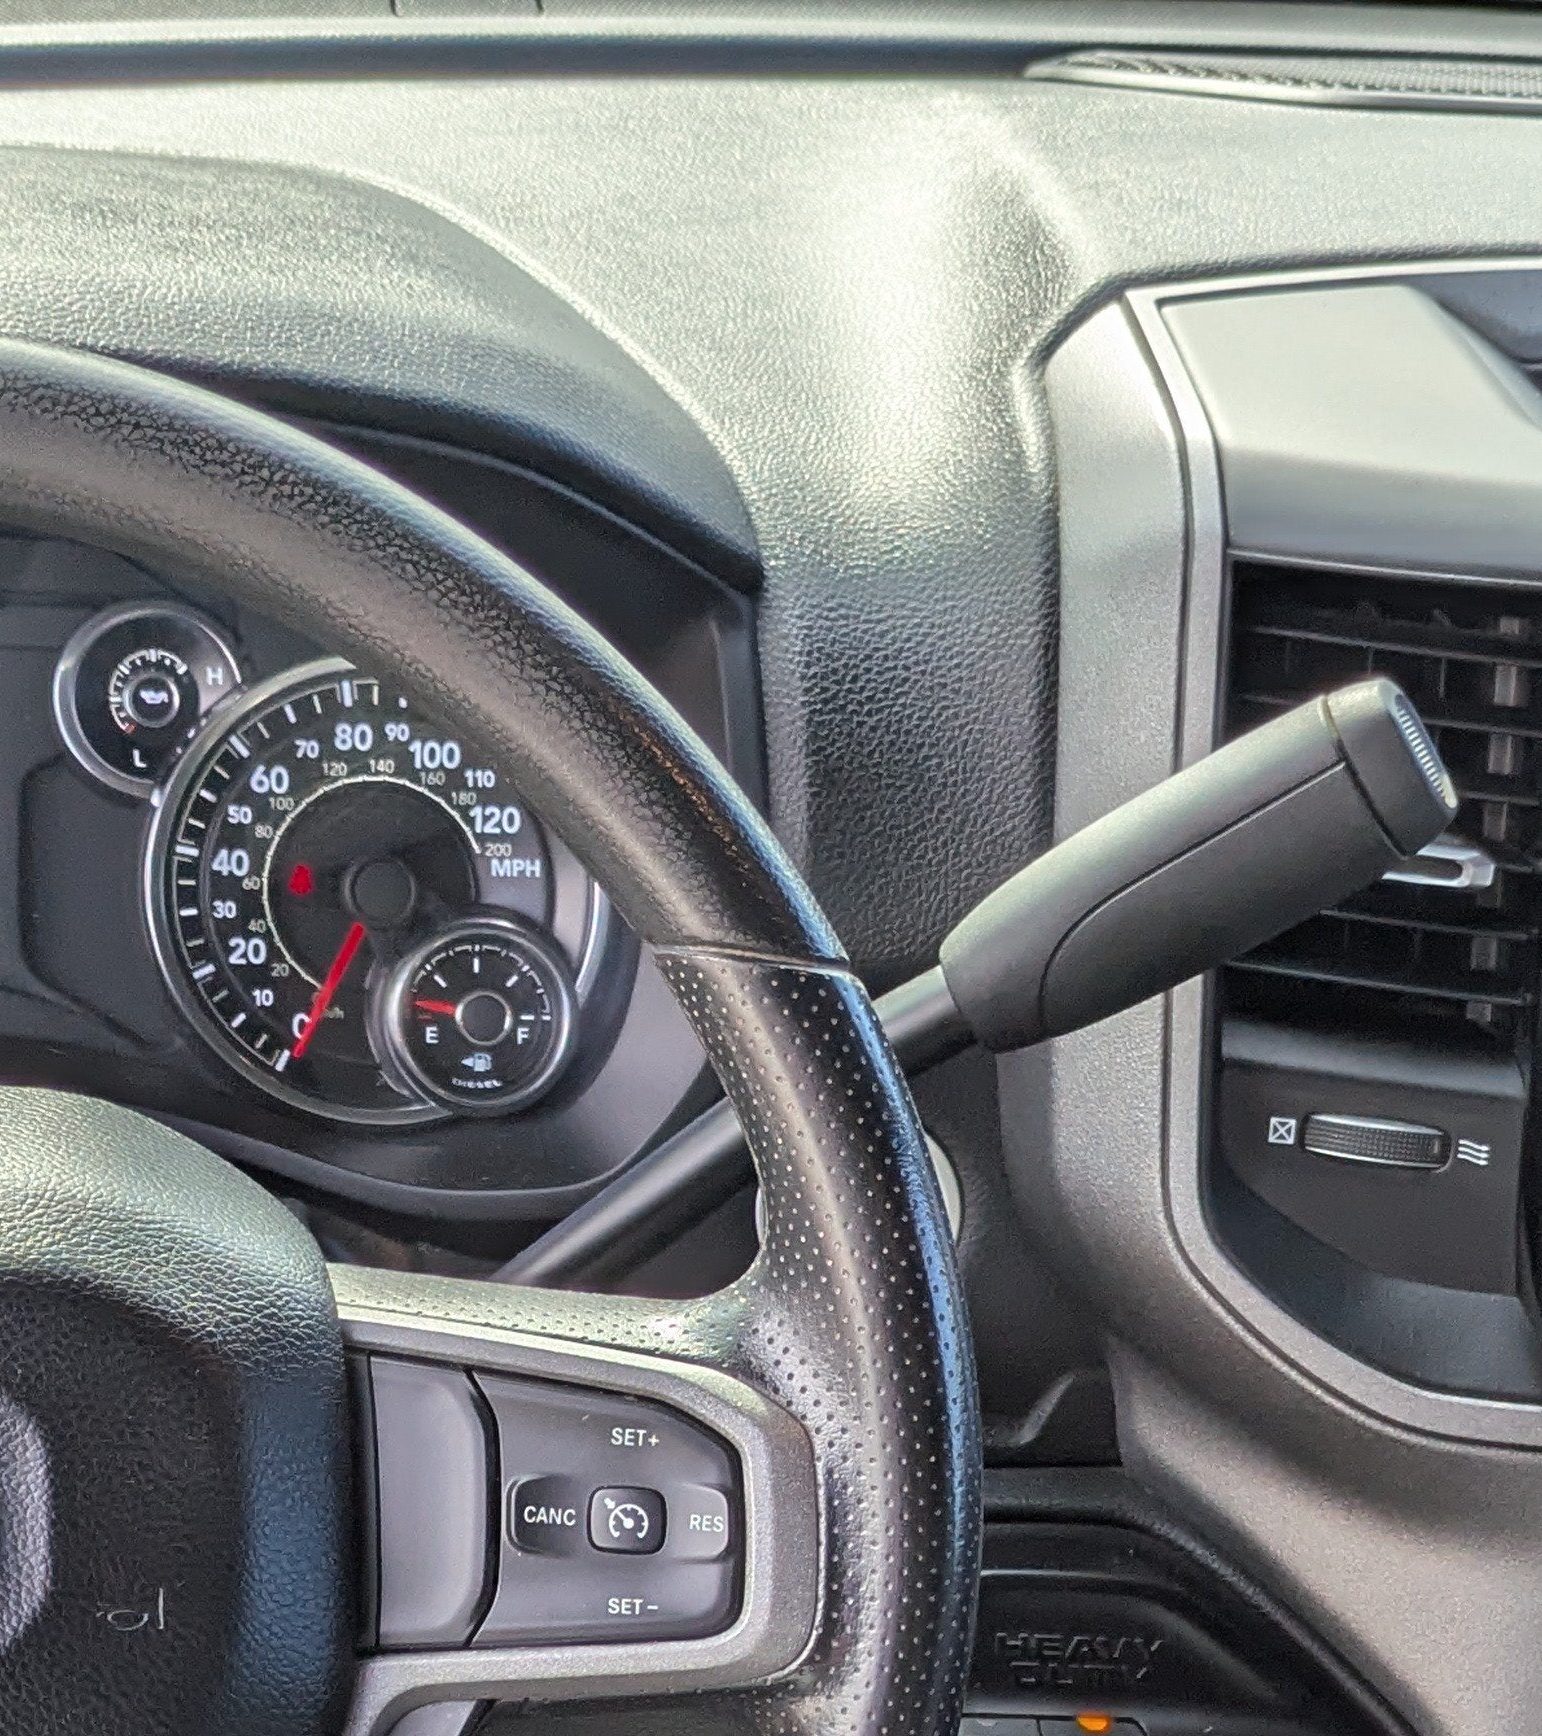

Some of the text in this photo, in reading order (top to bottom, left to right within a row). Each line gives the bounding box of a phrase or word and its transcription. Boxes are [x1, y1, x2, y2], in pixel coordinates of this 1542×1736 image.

[206, 666, 224, 686] H
[334, 723, 374, 751] 80
[384, 723, 410, 742] 90
[133, 749, 147, 768] L
[294, 739, 320, 759] 70
[409, 740, 462, 769] 100
[322, 762, 348, 777] 120
[368, 759, 396, 774] 140
[250, 765, 290, 795] 60
[420, 771, 446, 787] 160
[463, 768, 496, 788] 110
[269, 797, 295, 811] 100
[451, 791, 477, 806] 180
[227, 804, 253, 825] 50
[468, 804, 521, 834] 120
[254, 824, 274, 839] 80
[485, 843, 512, 858] 200
[211, 848, 250, 877] 40
[490, 858, 541, 878] MPH
[242, 876, 261, 891] 60
[212, 900, 237, 919] 30
[248, 918, 267, 933] 40
[228, 937, 267, 965] 20
[271, 962, 289, 977] 20
[252, 989, 274, 1007] 10
[425, 1026, 440, 1045] E
[516, 1027, 530, 1045] F
[523, 1506, 577, 1527] CANC
[688, 1514, 724, 1533] RES
[995, 1632, 1163, 1660] HEAVY
